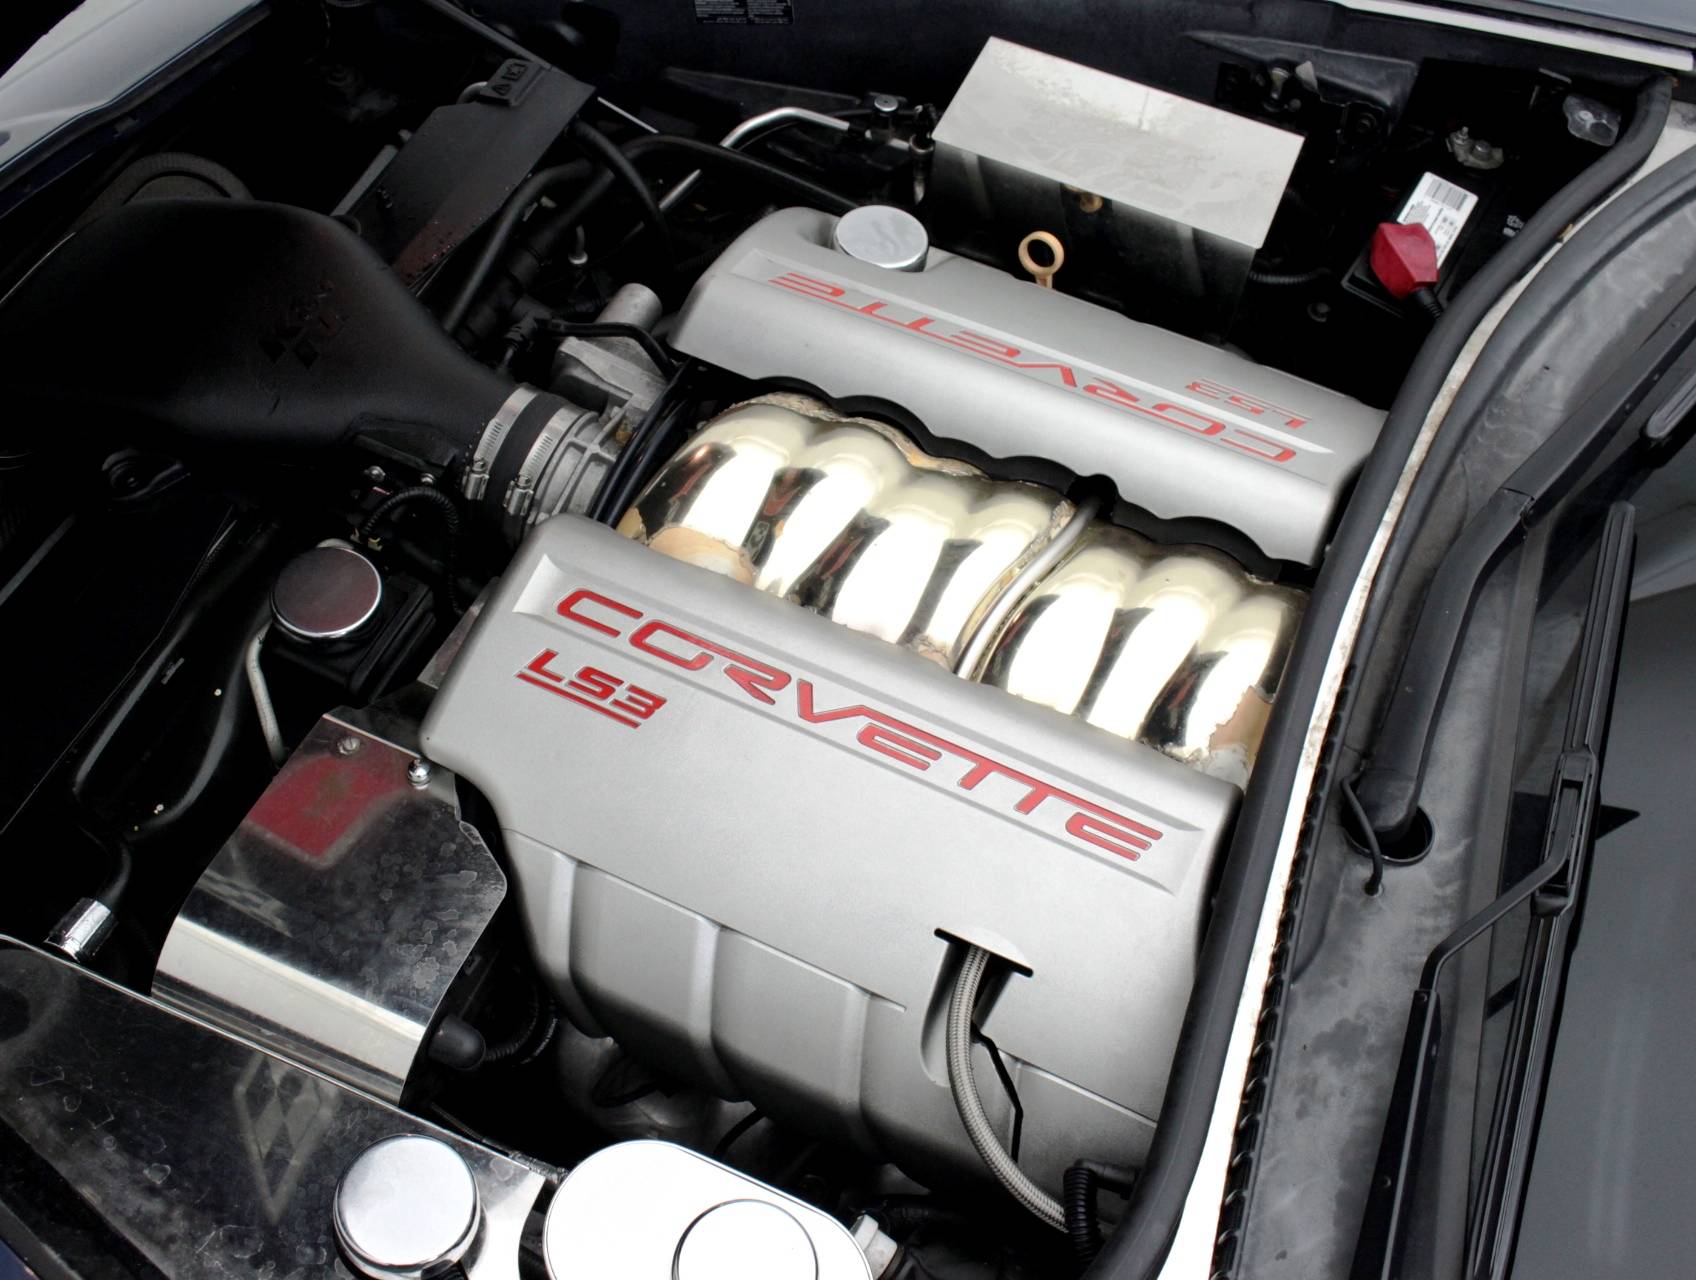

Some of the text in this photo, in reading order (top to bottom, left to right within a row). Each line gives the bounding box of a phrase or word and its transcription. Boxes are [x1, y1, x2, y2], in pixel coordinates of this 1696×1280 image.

[768, 271, 1296, 463] CORVETTE
[1185, 378, 1313, 429] LS3
[524, 648, 667, 722] LS3
[556, 587, 1163, 861] CORVETTE
